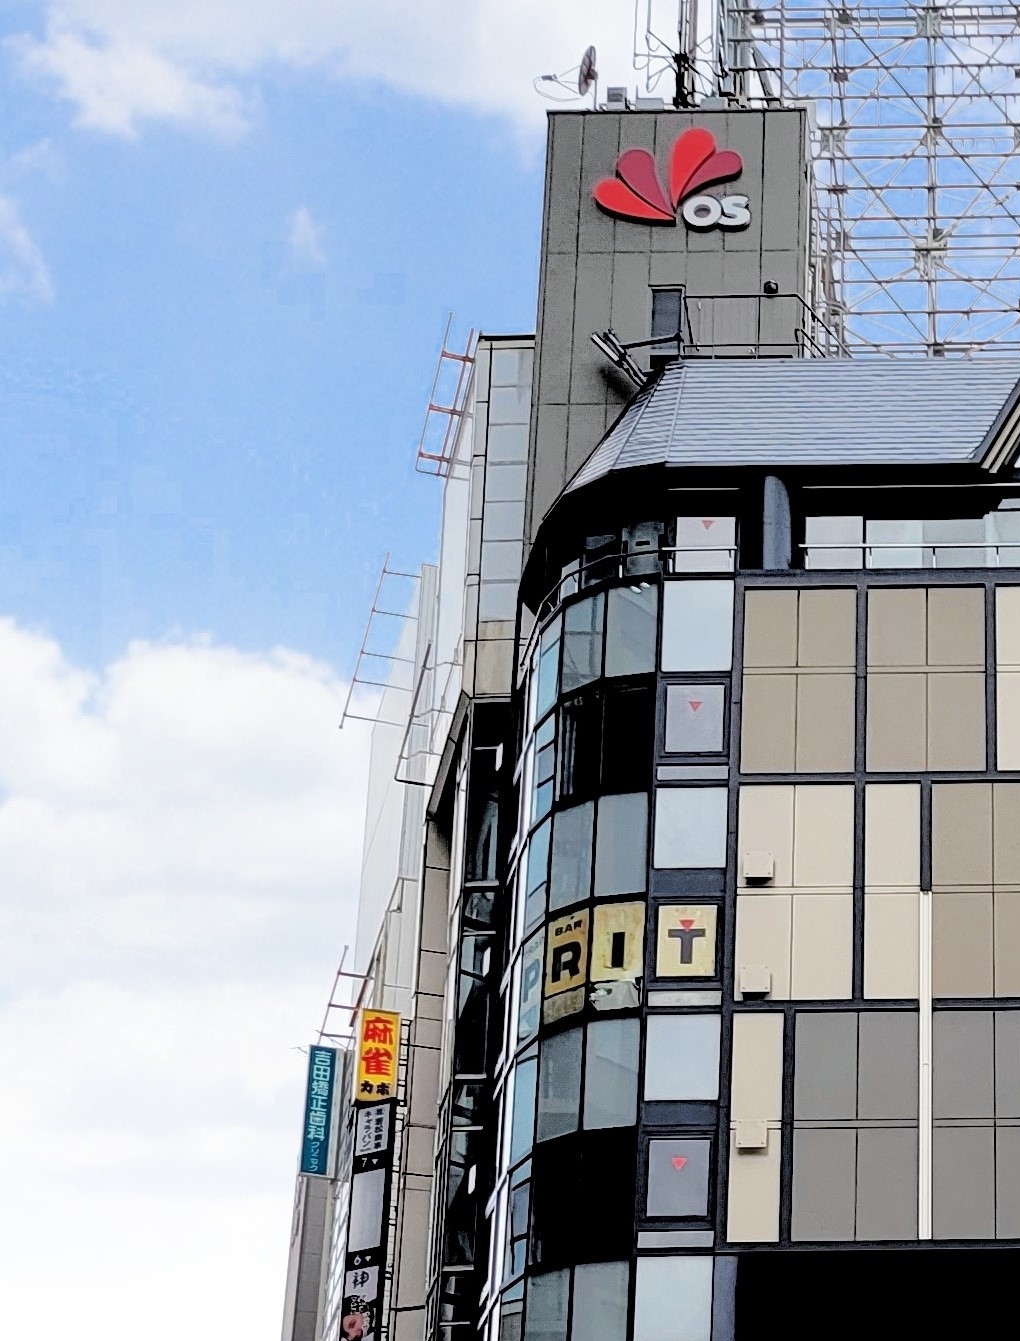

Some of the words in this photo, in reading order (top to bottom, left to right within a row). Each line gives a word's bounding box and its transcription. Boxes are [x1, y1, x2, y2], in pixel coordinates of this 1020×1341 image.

[683, 195, 751, 231] OS
[554, 919, 582, 936] BAR
[361, 1016, 394, 1077] 麻雀
[361, 1157, 368, 1168] 7
